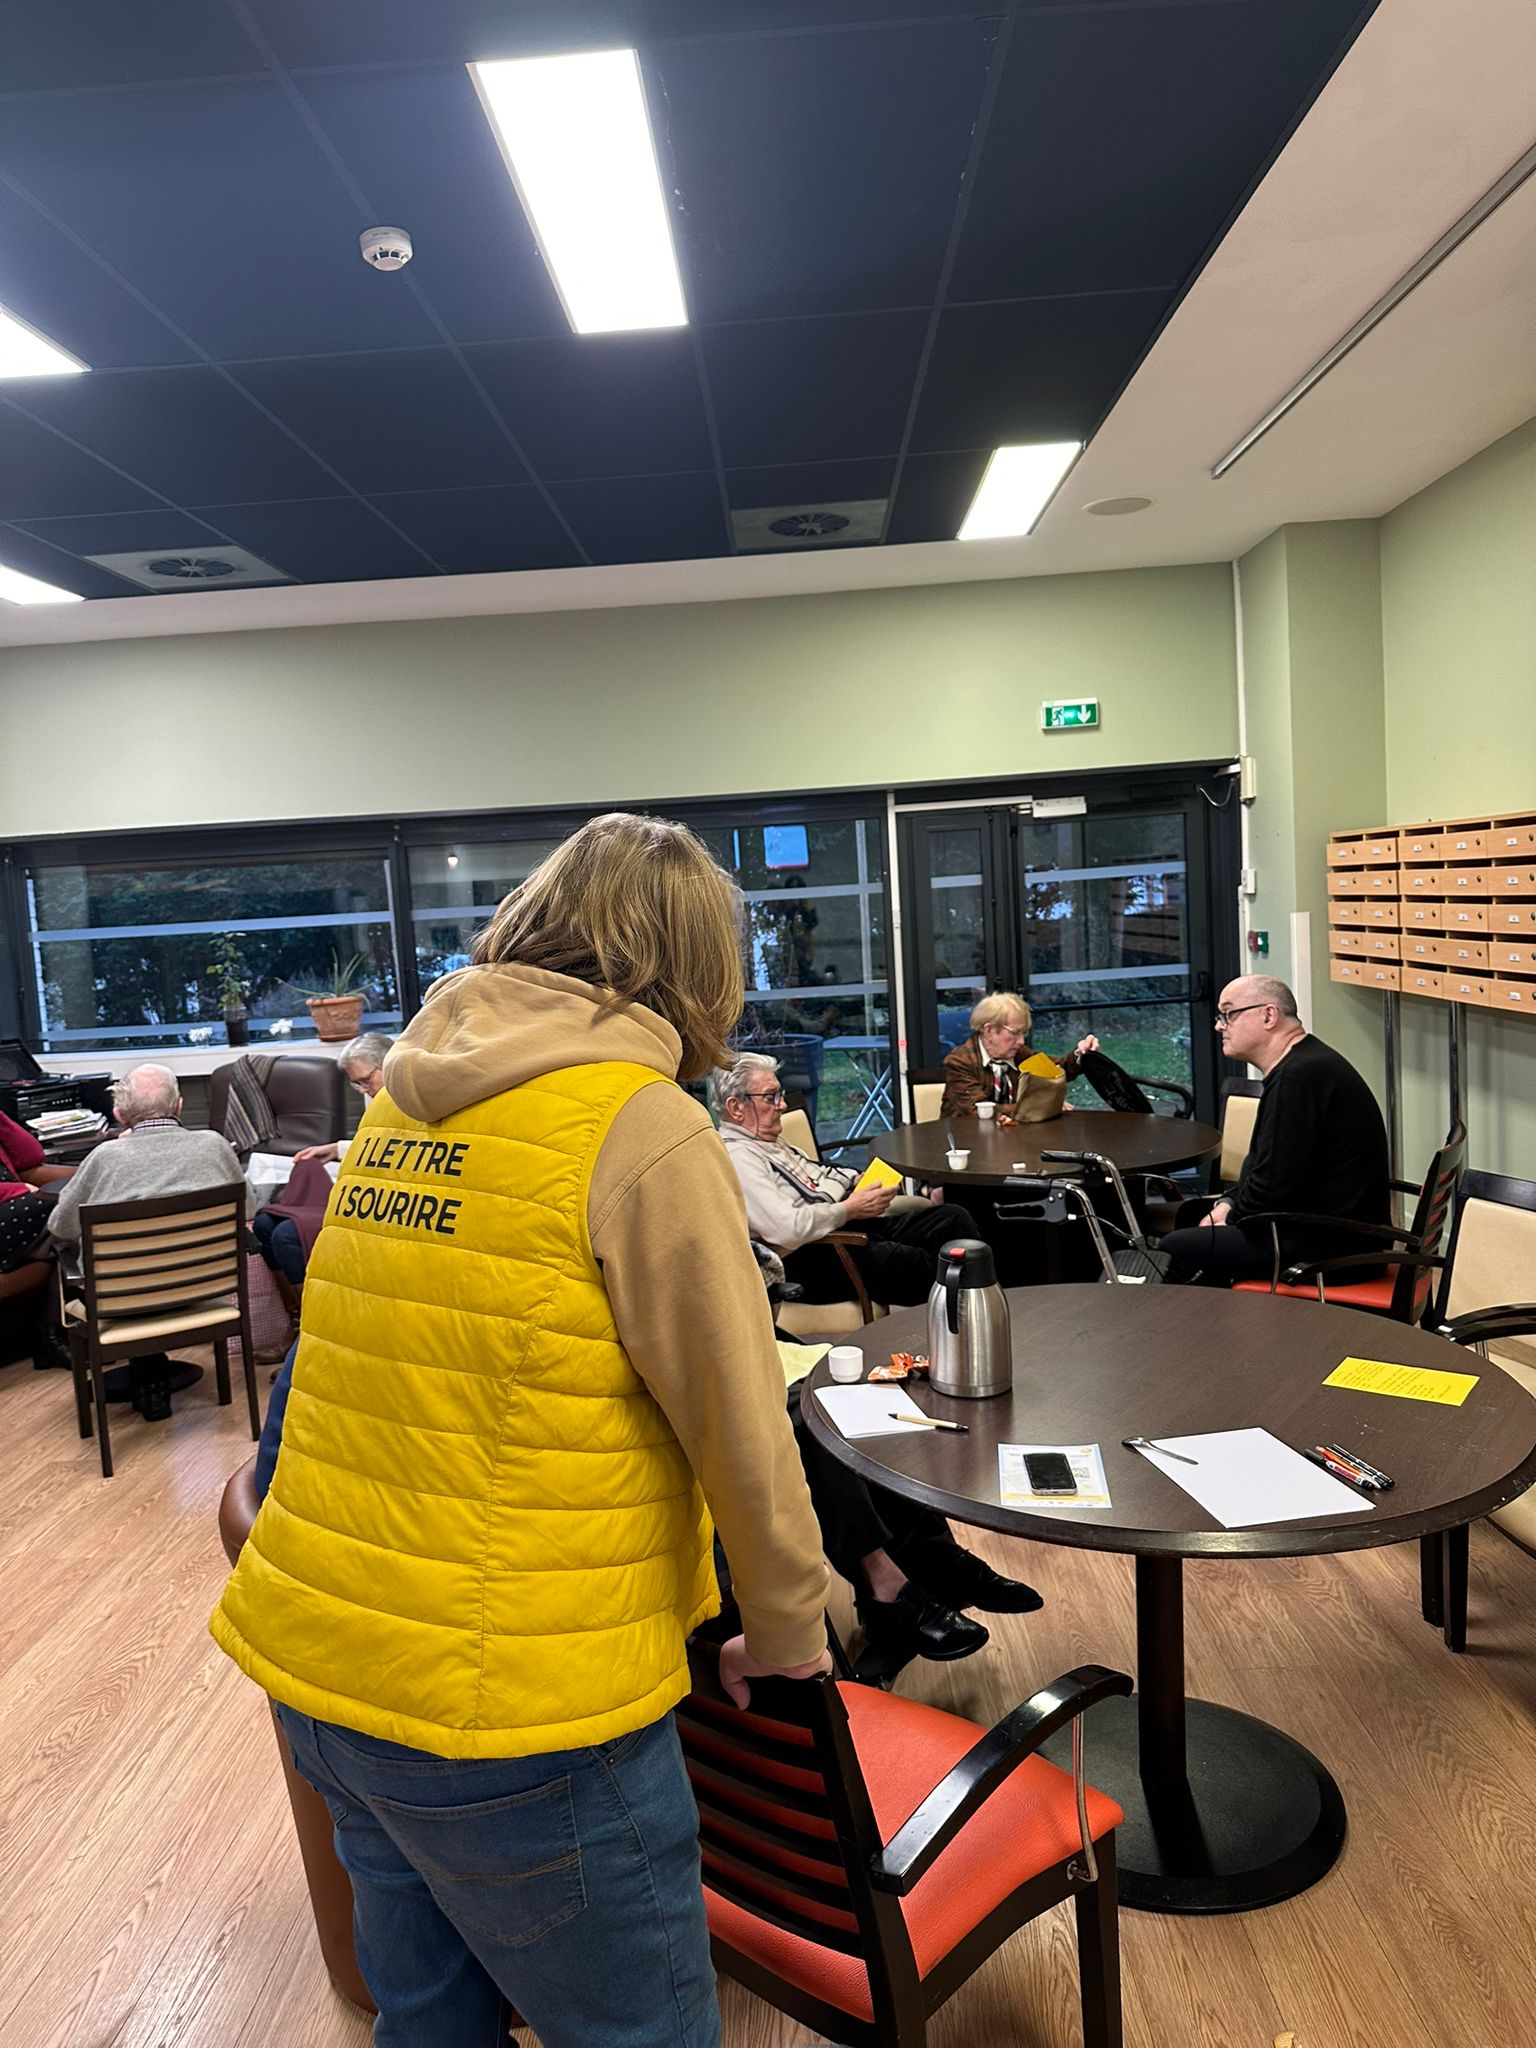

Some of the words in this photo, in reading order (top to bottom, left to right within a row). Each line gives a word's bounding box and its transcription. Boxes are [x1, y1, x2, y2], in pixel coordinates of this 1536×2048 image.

[356, 1137, 371, 1167] 1
[365, 1137, 470, 1177] LETTRE
[335, 1185, 347, 1216] 1
[343, 1185, 463, 1235] SOURIRE
